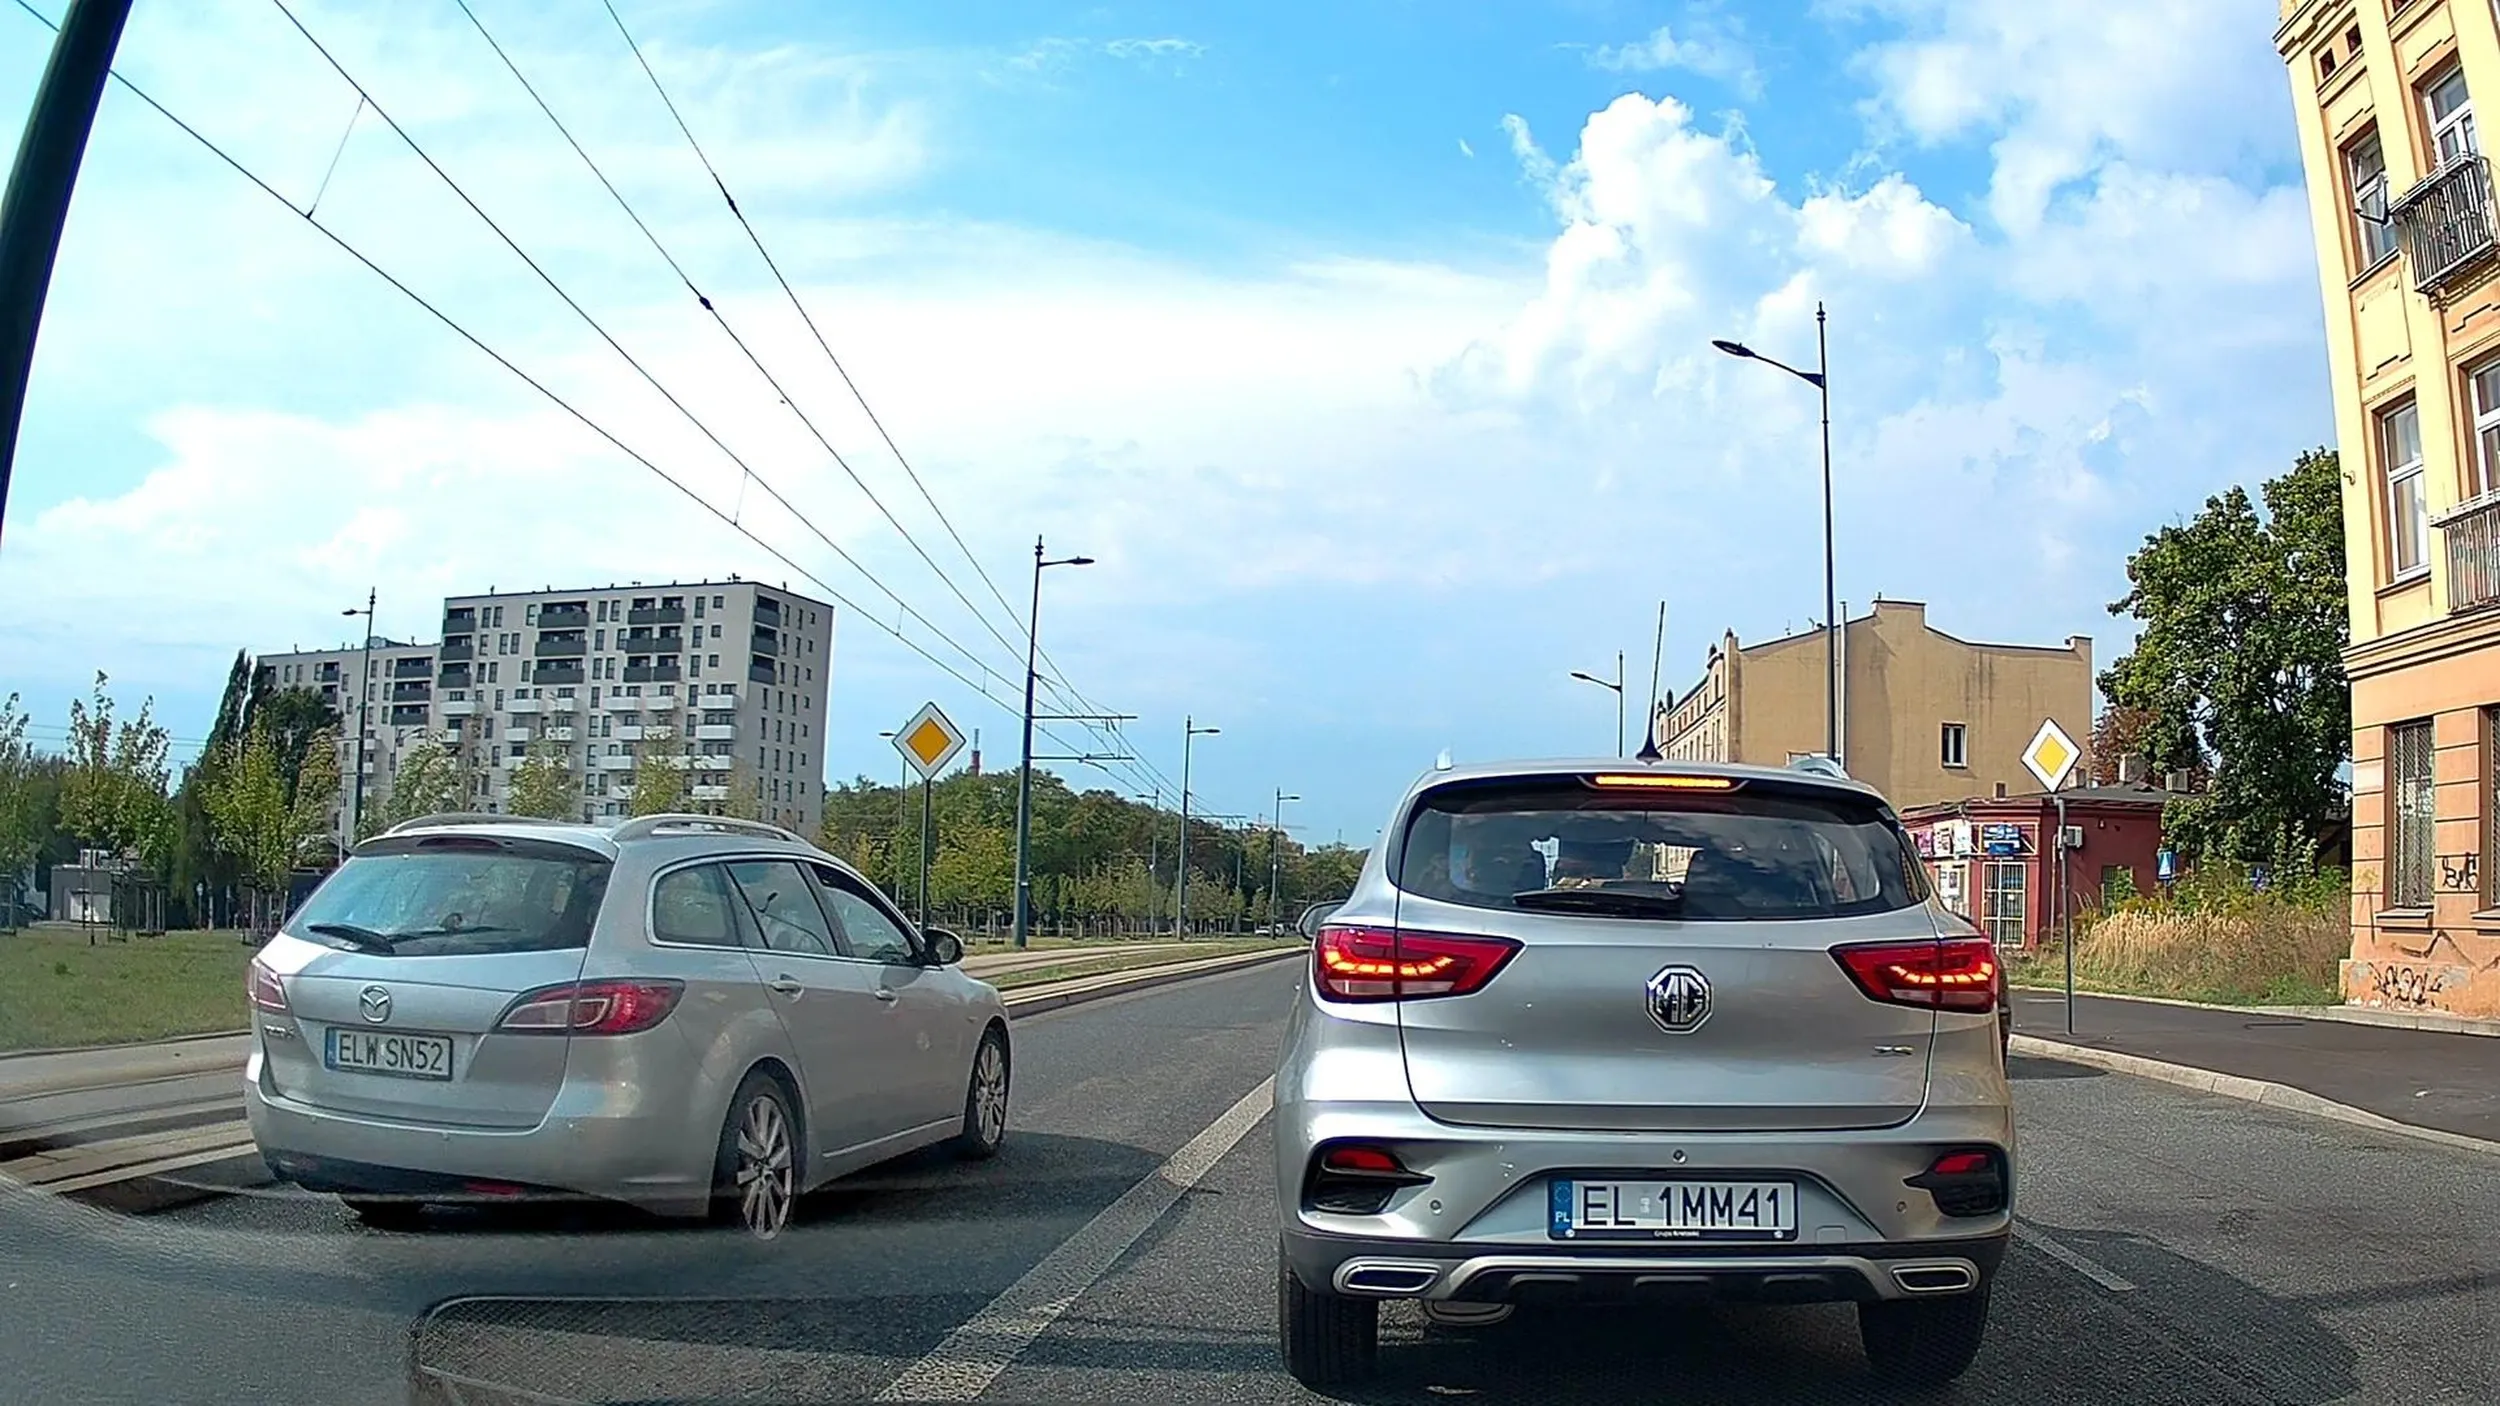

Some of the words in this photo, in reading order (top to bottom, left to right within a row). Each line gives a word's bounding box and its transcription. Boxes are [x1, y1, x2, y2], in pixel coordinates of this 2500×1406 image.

[1648, 972, 1706, 1023] MG
[338, 1033, 379, 1067] ELW
[385, 1036, 443, 1072] SN52
[1555, 1211, 1570, 1223] PL
[1583, 1186, 1636, 1226] EL
[1658, 1186, 1780, 1227] 1MM41
